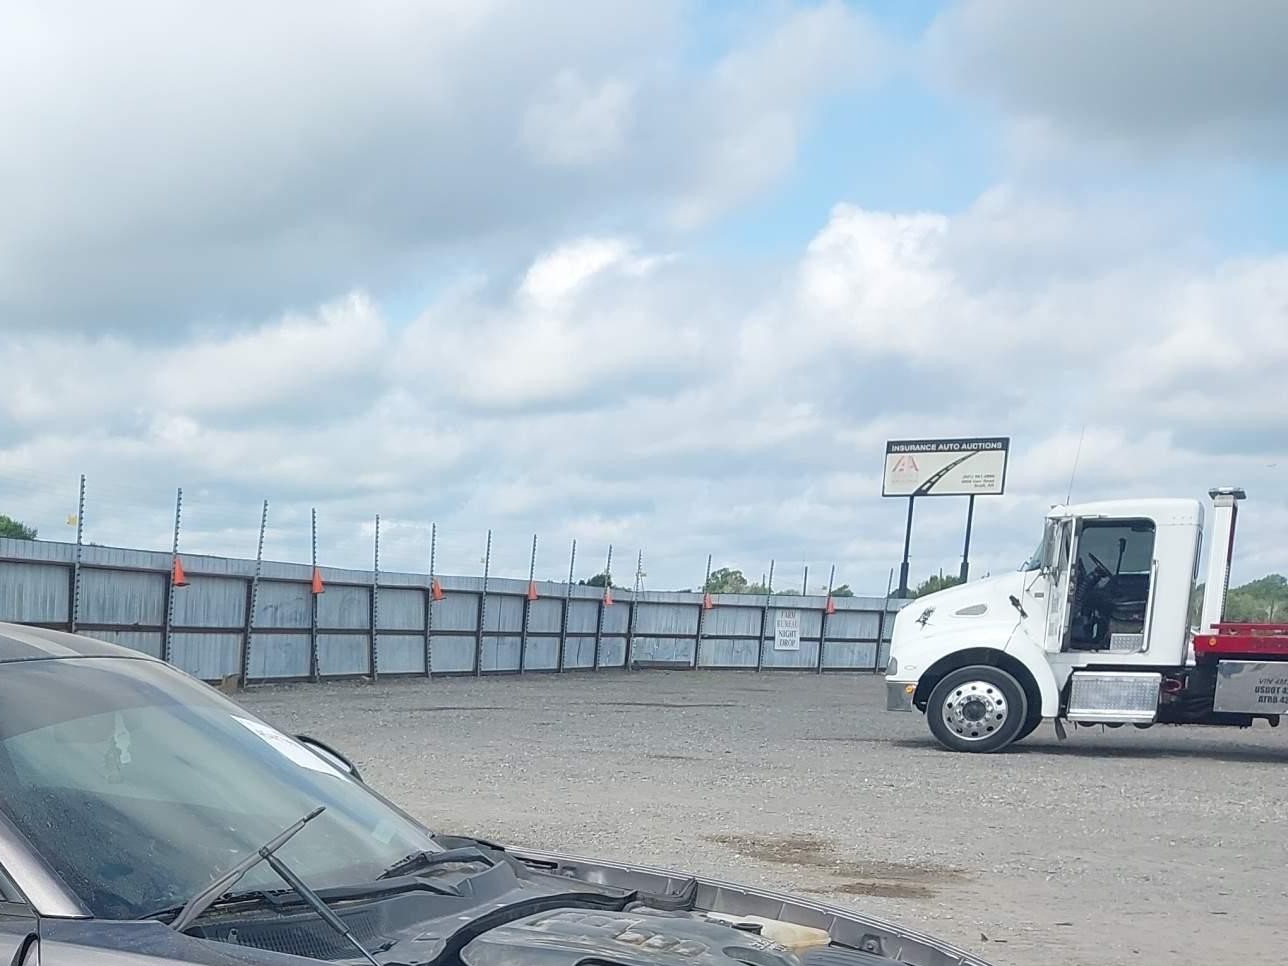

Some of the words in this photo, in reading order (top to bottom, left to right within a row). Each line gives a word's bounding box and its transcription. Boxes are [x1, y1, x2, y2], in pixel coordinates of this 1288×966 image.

[892, 443, 936, 452] INSURANCE
[961, 441, 1002, 450] AUCTIONS
[779, 630, 797, 638] NIGHT
[779, 639, 796, 647] DROP
[1254, 686, 1281, 694] USDOT
